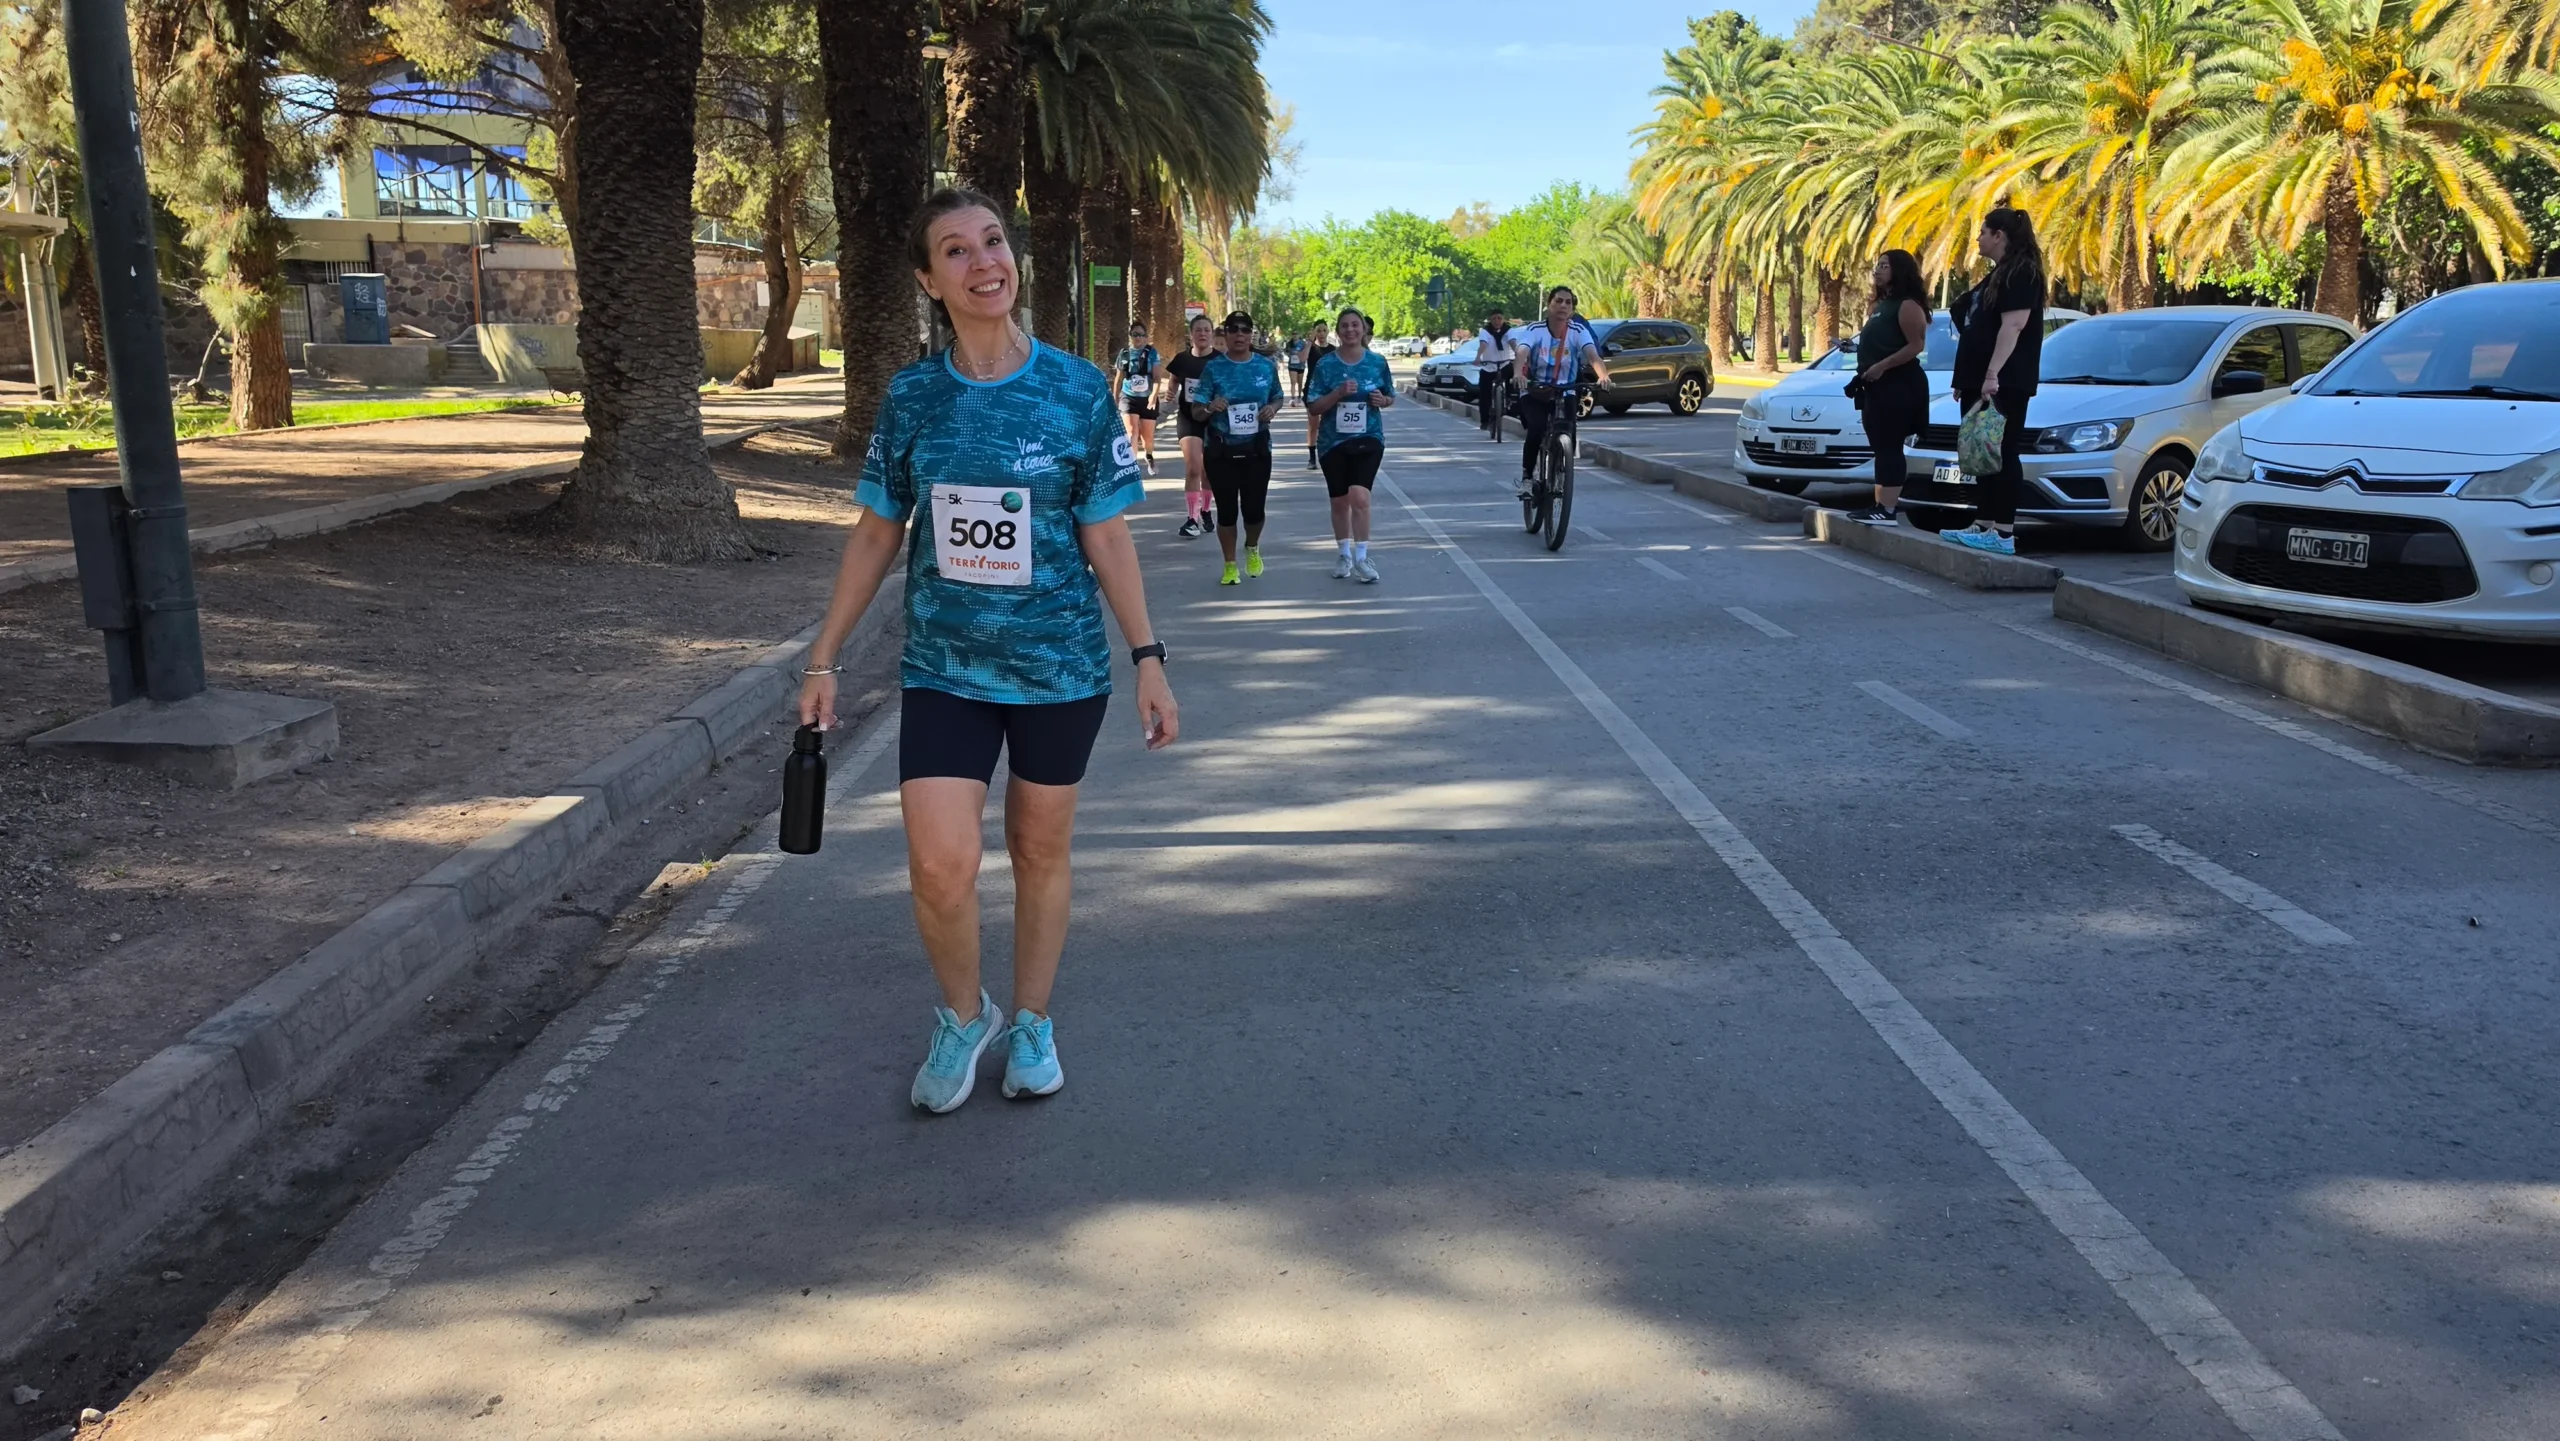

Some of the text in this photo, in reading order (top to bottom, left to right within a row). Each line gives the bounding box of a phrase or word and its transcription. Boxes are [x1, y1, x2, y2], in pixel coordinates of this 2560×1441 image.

[1234, 413, 1254, 424] 548
[1343, 412, 1360, 422] 515
[1935, 468, 1950, 480] AD
[948, 493, 963, 506] 5k
[949, 517, 1017, 551] 508
[2290, 536, 2365, 562] MNG 914
[949, 555, 1020, 571] TERRITORIO
